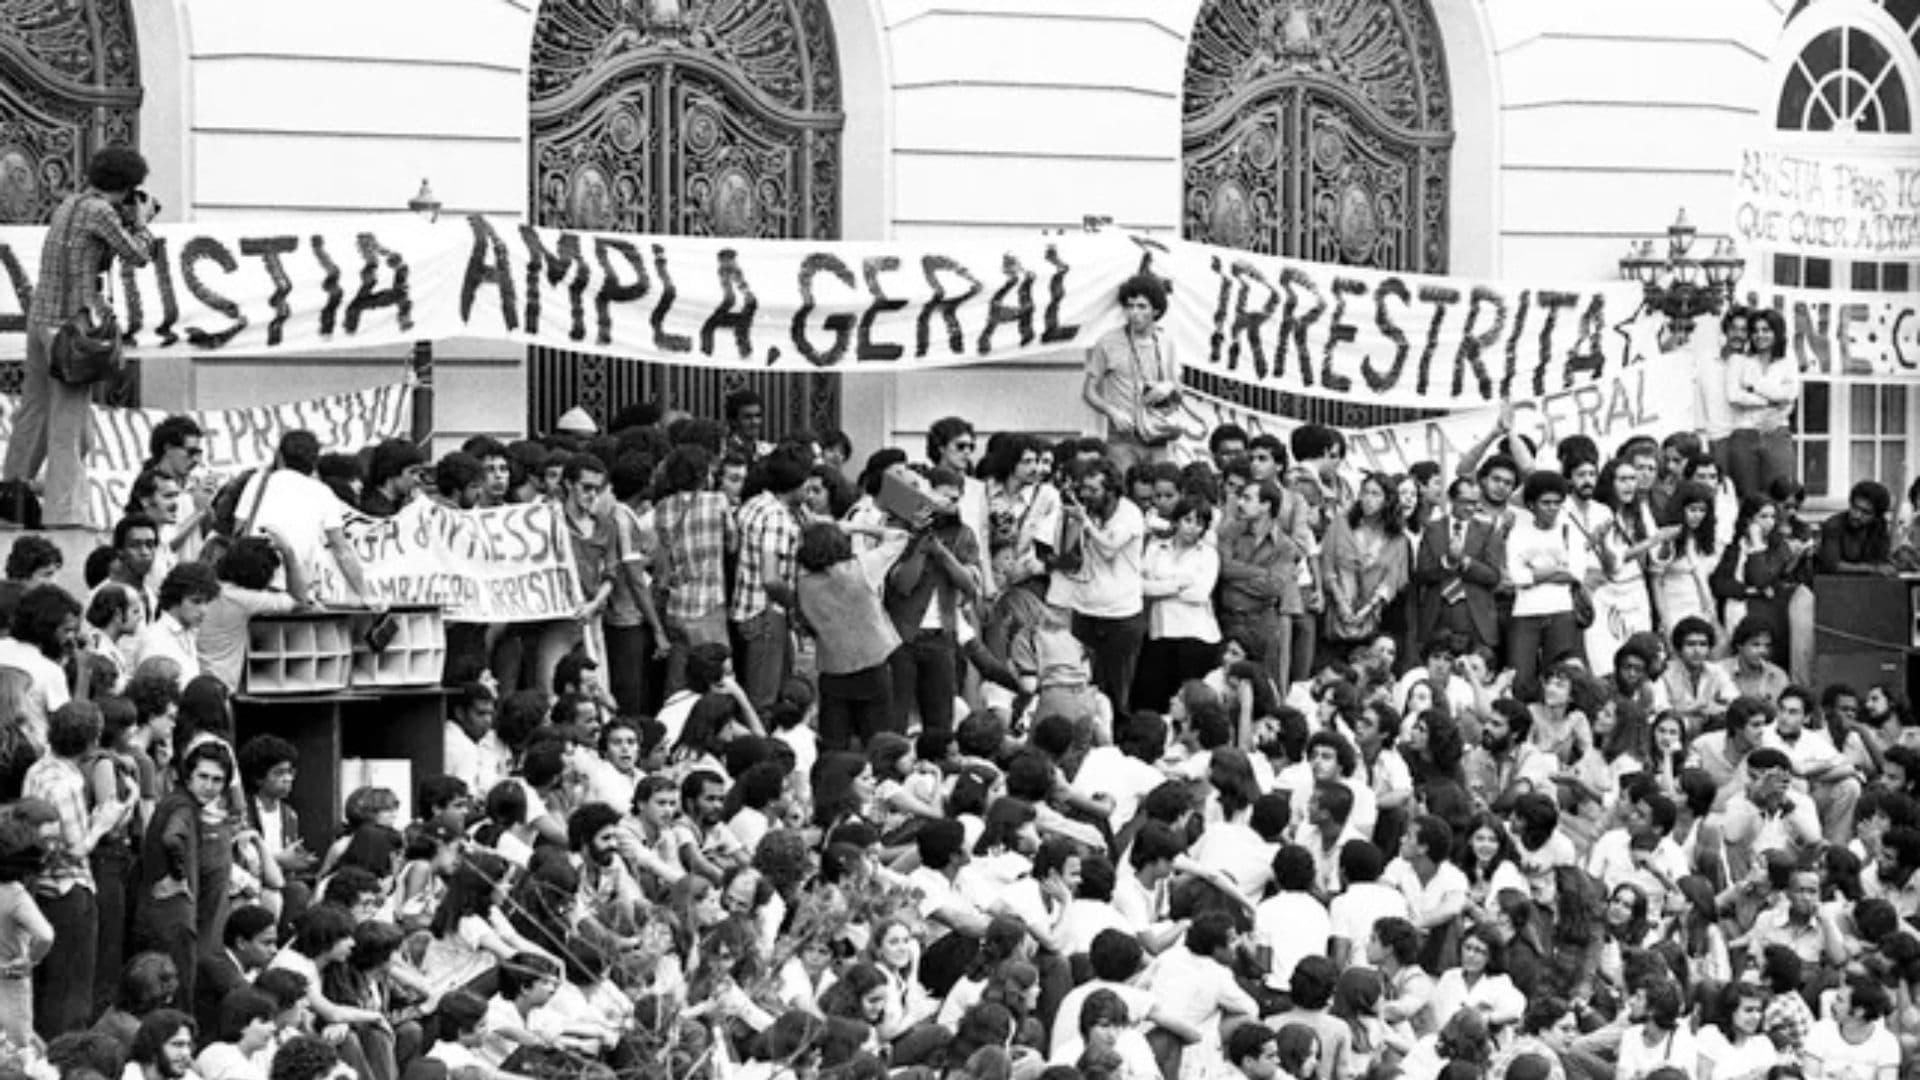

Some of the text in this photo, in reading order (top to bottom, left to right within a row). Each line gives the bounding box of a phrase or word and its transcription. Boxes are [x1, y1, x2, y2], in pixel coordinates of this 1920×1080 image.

[1736, 202, 1782, 241] QUE
[1789, 211, 1847, 248] QUER
[0, 232, 413, 347] AISTIA
[1210, 255, 1606, 400] IRRESTRITA
